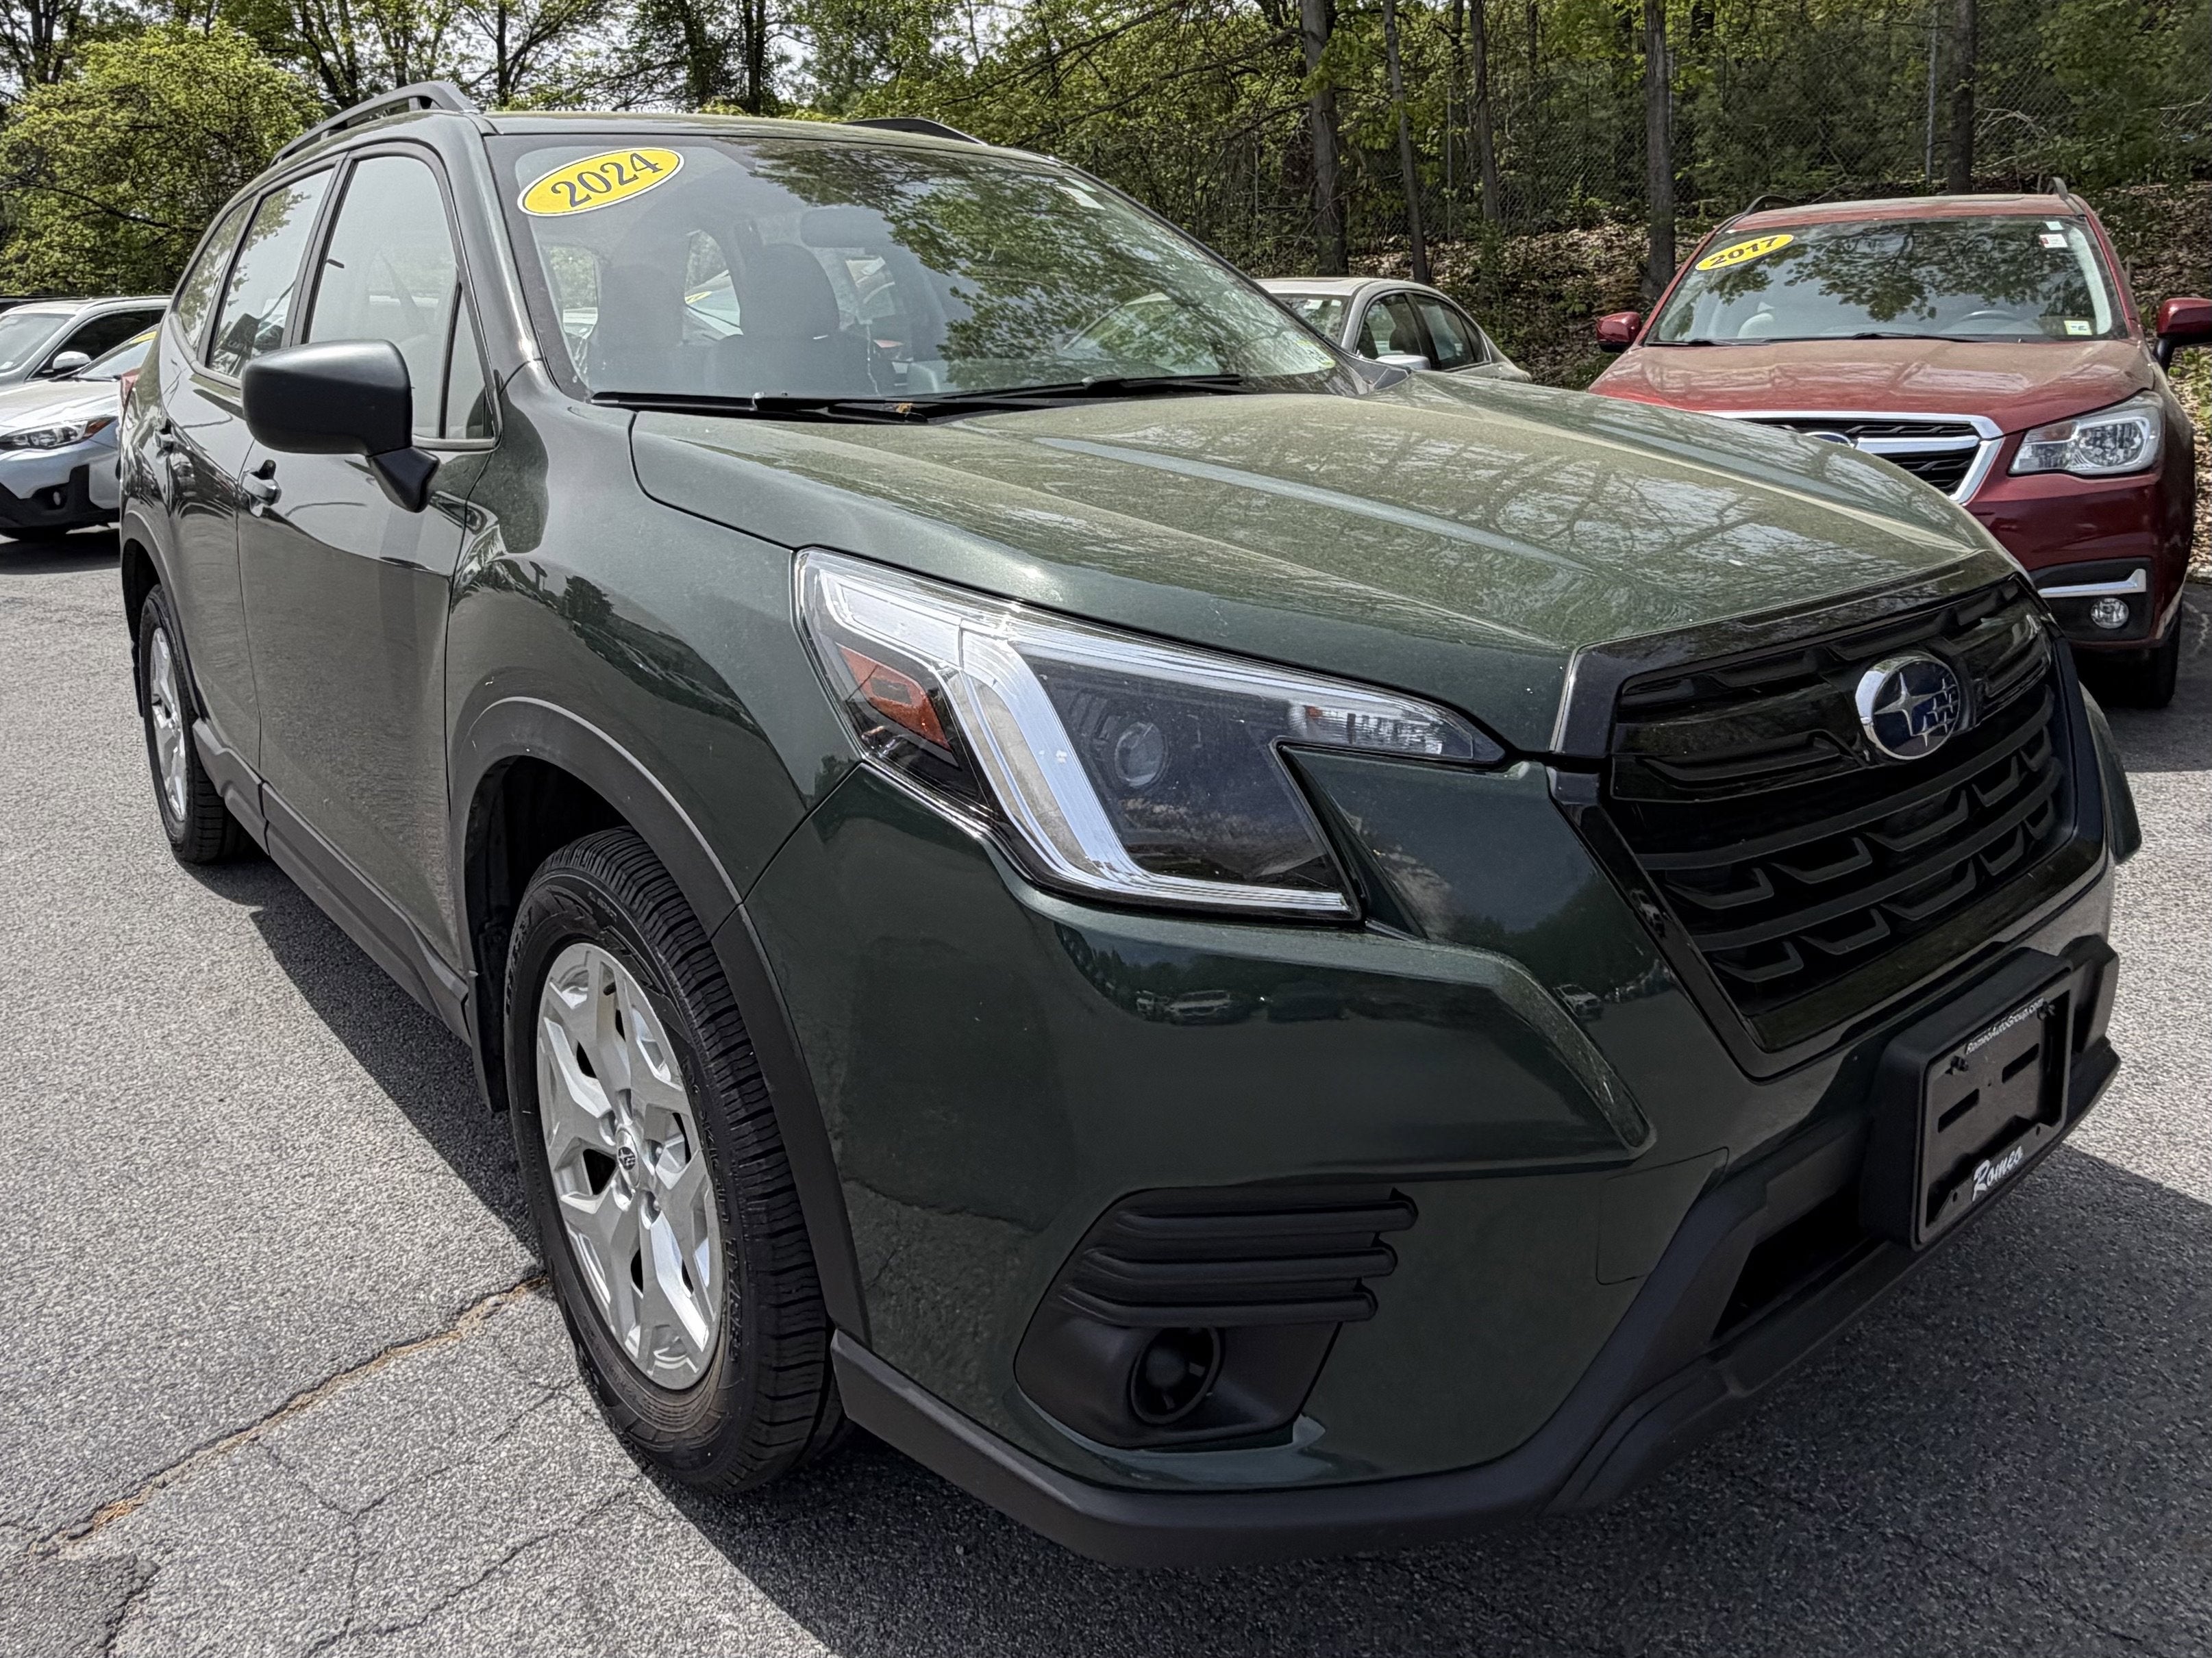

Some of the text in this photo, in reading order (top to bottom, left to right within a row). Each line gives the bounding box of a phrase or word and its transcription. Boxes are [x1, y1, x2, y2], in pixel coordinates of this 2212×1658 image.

[551, 152, 664, 208] 2024
[1709, 237, 1779, 267] 2017
[1972, 1145, 2024, 1203] Romeo
